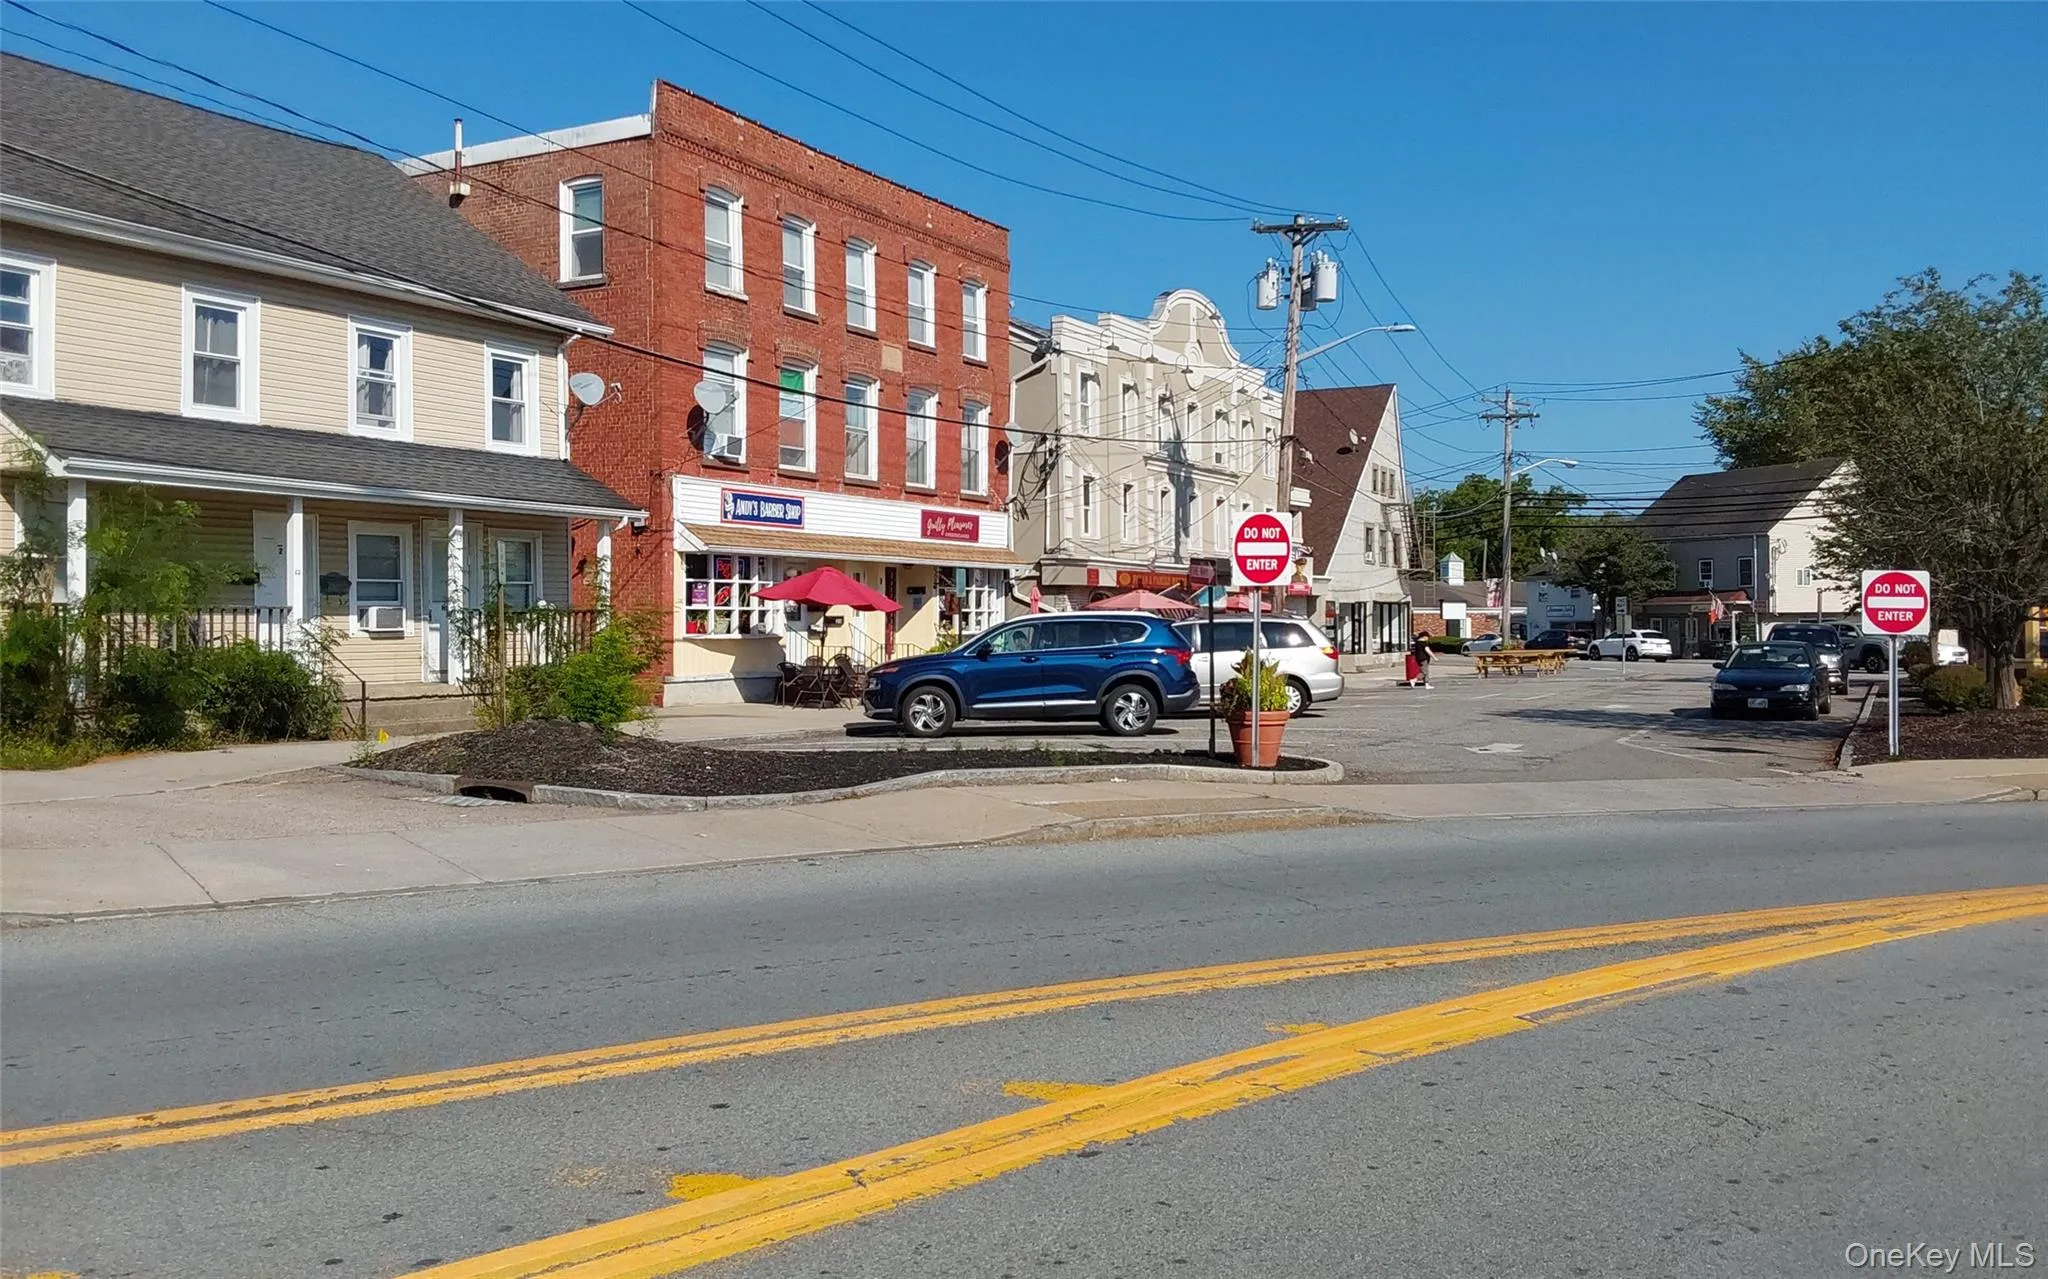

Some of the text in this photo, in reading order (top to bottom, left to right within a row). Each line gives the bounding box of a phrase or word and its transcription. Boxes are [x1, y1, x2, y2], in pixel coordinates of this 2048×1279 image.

[735, 498, 802, 520] ANDY'S BARBER SHOP
[1244, 527, 1281, 539] DO NOT
[1246, 558, 1278, 571] ENTER
[1874, 583, 1917, 594] DO NOT
[1877, 610, 1914, 621] ENTER
